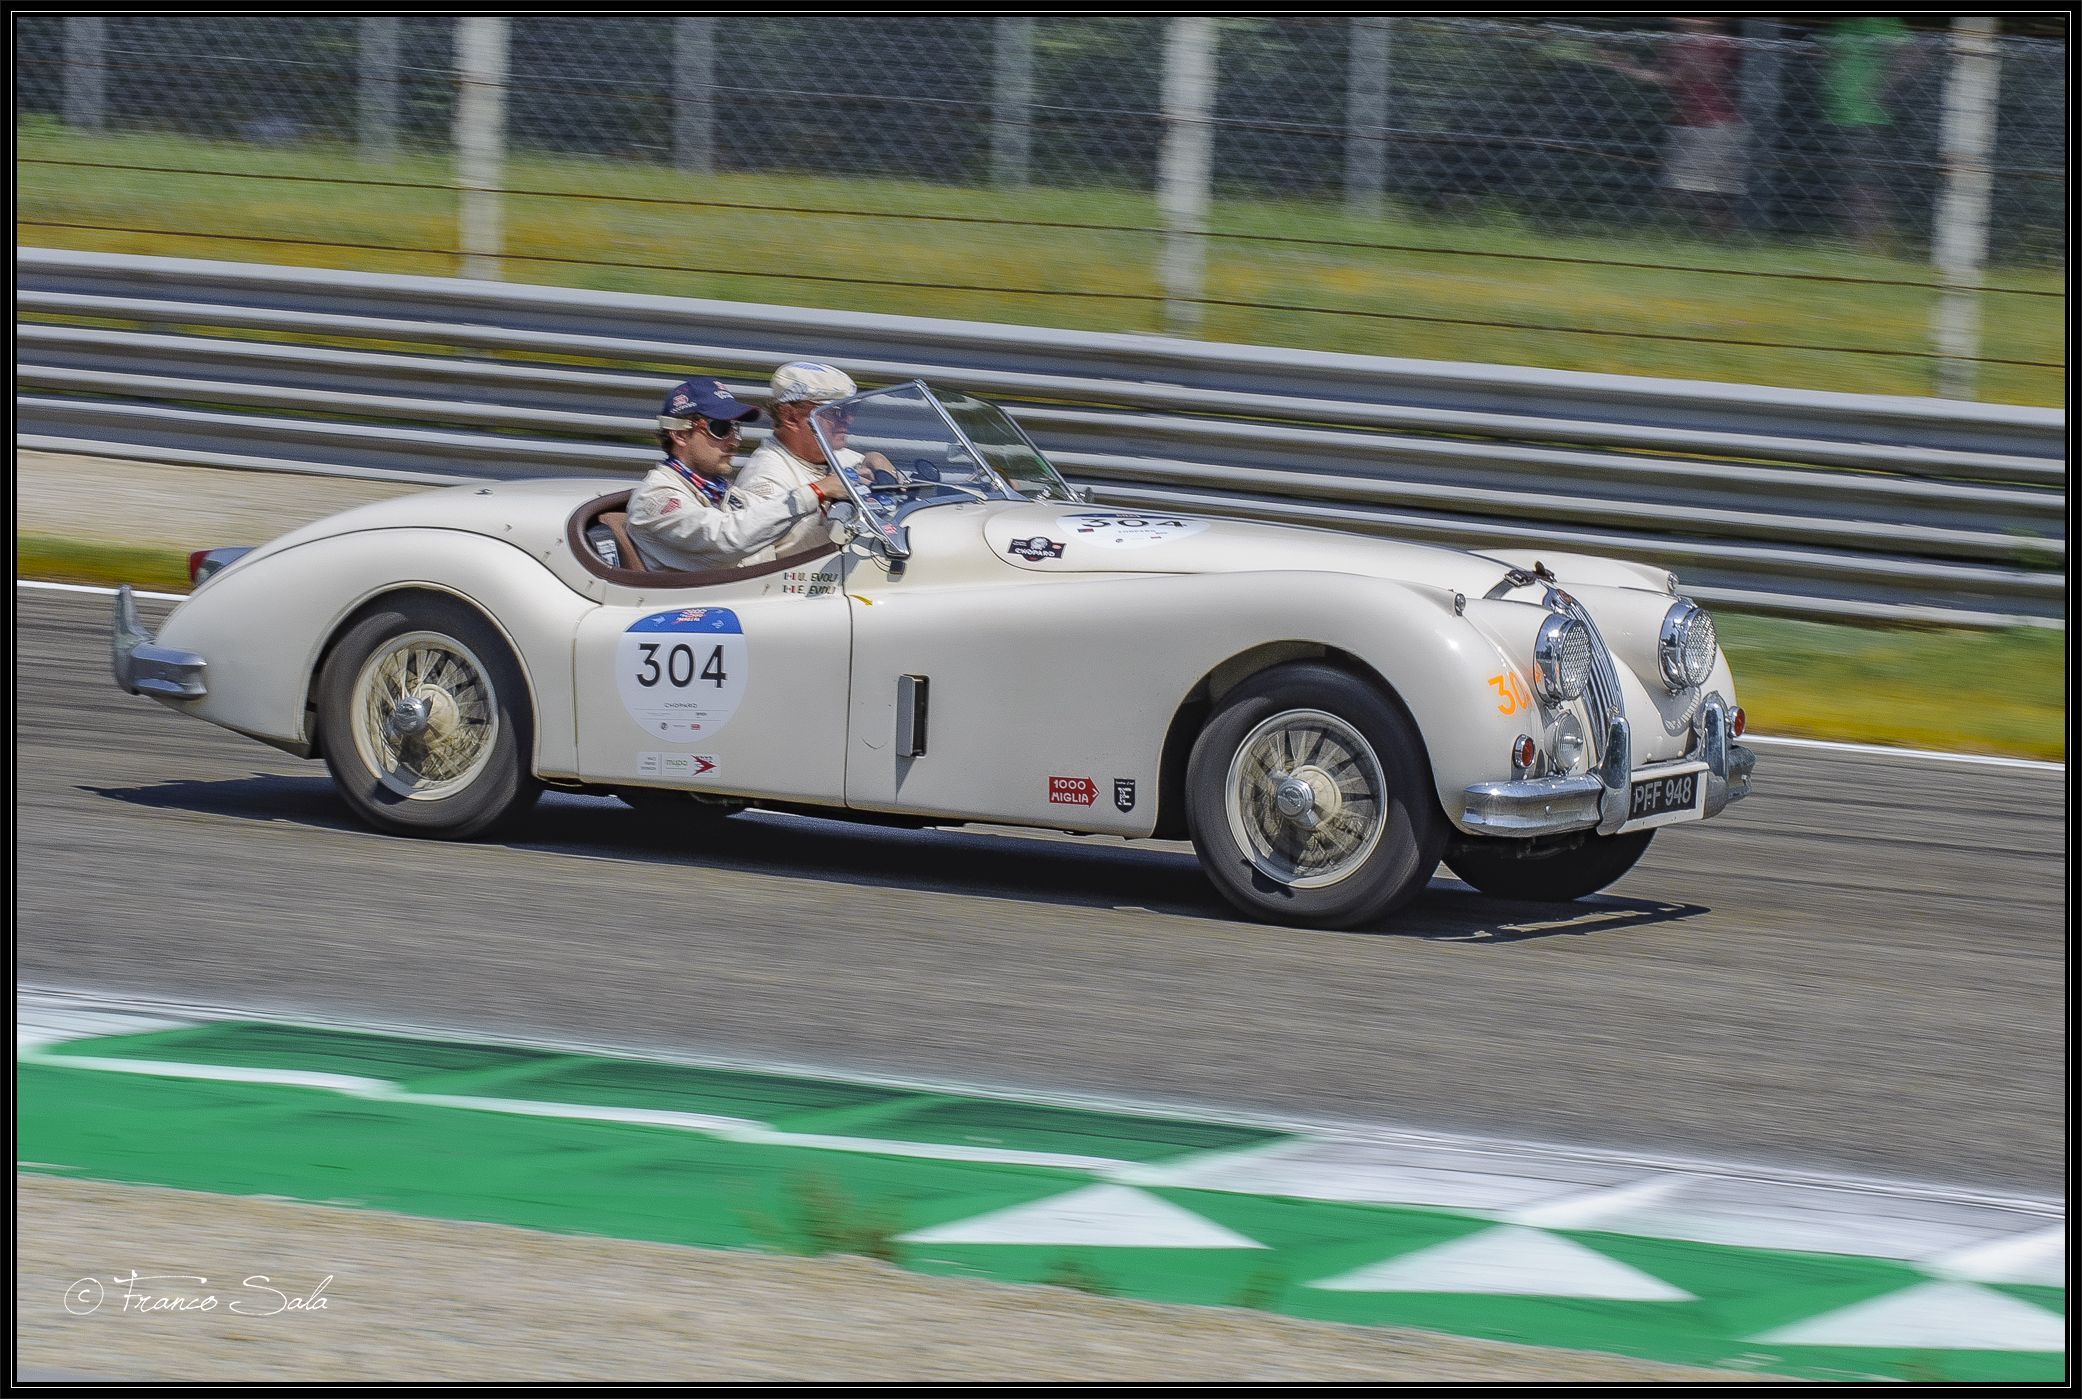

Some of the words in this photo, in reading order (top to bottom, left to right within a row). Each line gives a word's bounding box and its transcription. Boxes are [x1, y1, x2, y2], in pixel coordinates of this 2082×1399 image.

[1080, 518, 1187, 527] 304
[1014, 548, 1056, 557] CHOPARD
[636, 643, 728, 689] 304
[1053, 779, 1087, 791] 1000
[1051, 791, 1089, 803] MIGLIA
[1633, 781, 1662, 813] PFF
[1665, 776, 1692, 806] 948
